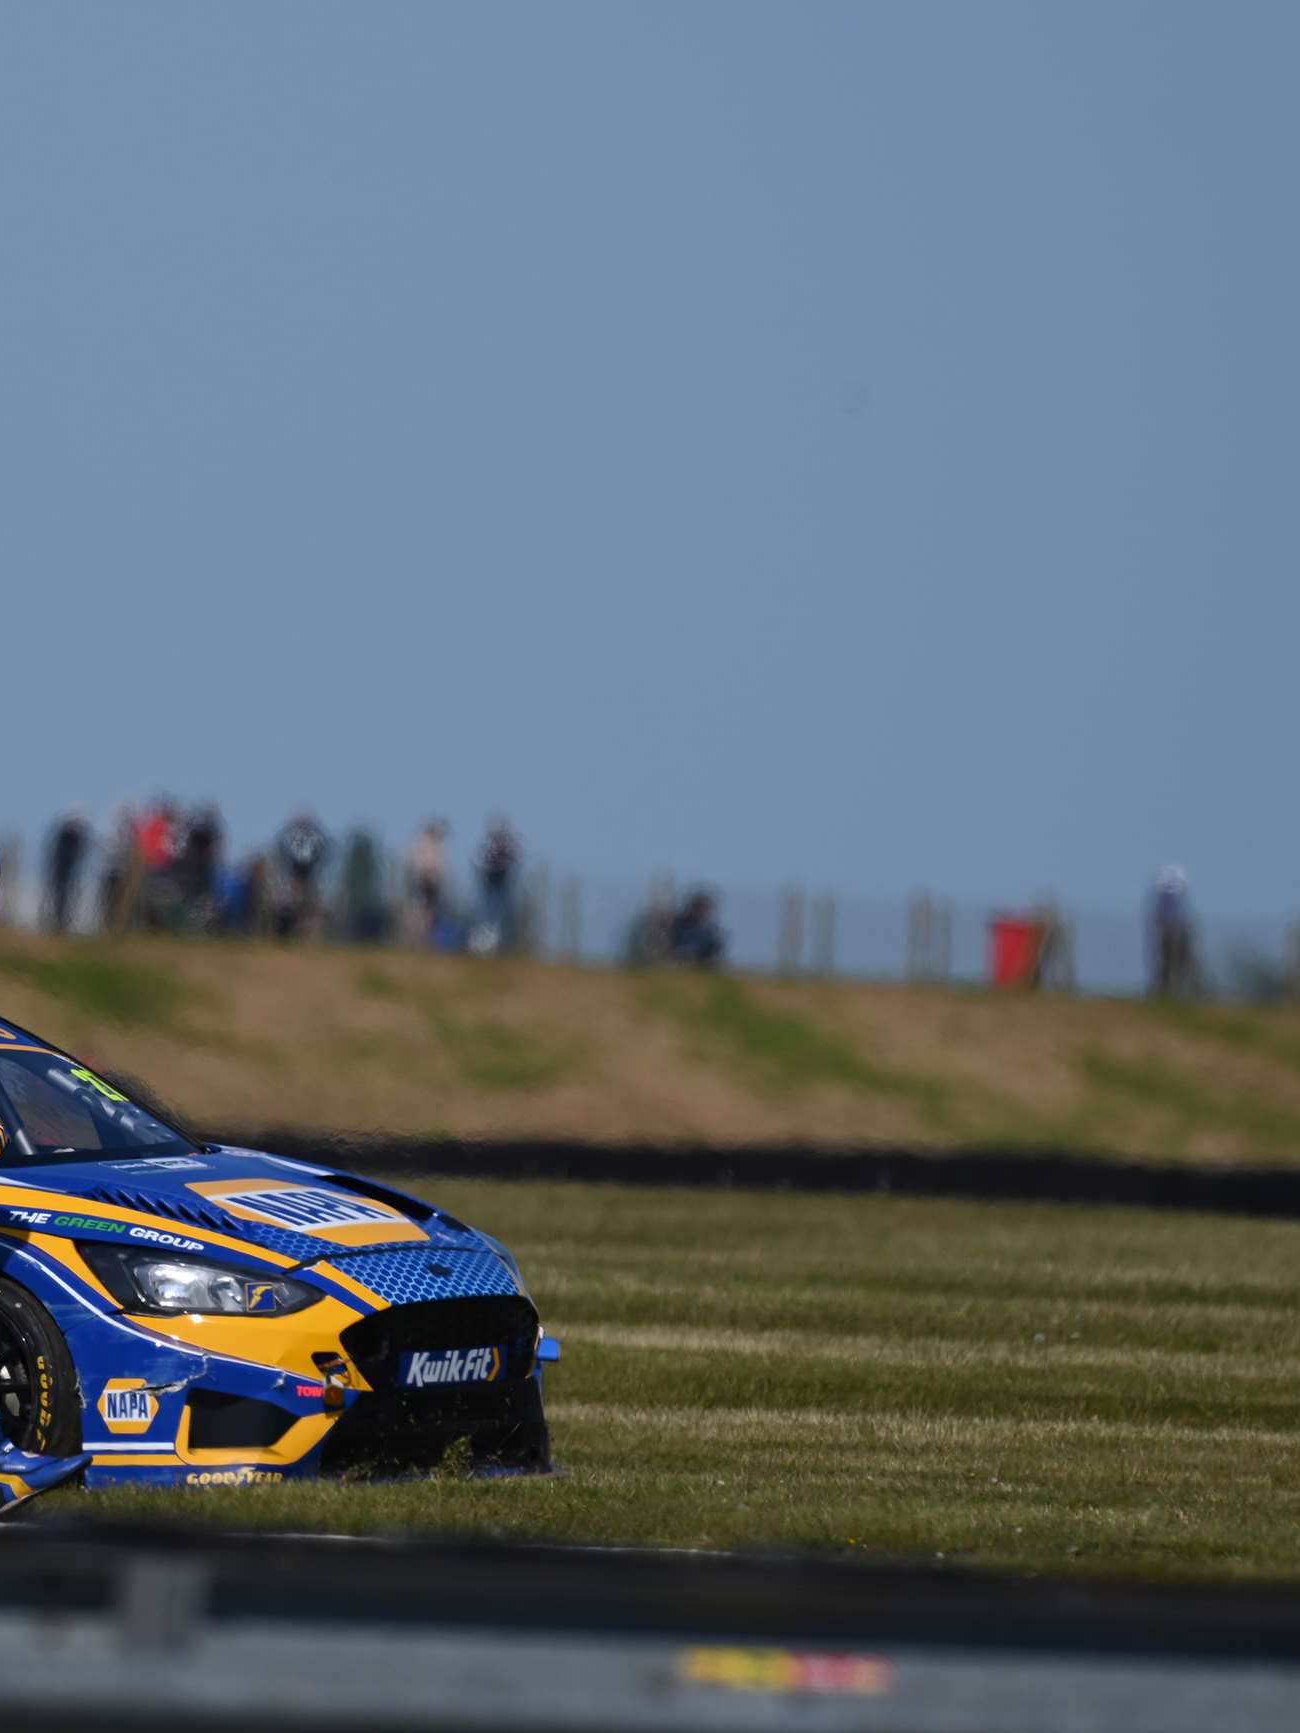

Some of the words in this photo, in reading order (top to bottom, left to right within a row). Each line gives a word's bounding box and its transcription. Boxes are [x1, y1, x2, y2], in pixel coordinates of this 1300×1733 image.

[224, 1191, 396, 1227] NAPA
[10, 1210, 52, 1225] THE
[54, 1215, 127, 1234] GREEN
[129, 1227, 205, 1251] GROUP
[107, 1392, 149, 1419] NAPA
[186, 1467, 283, 1487] GOODYEAR
